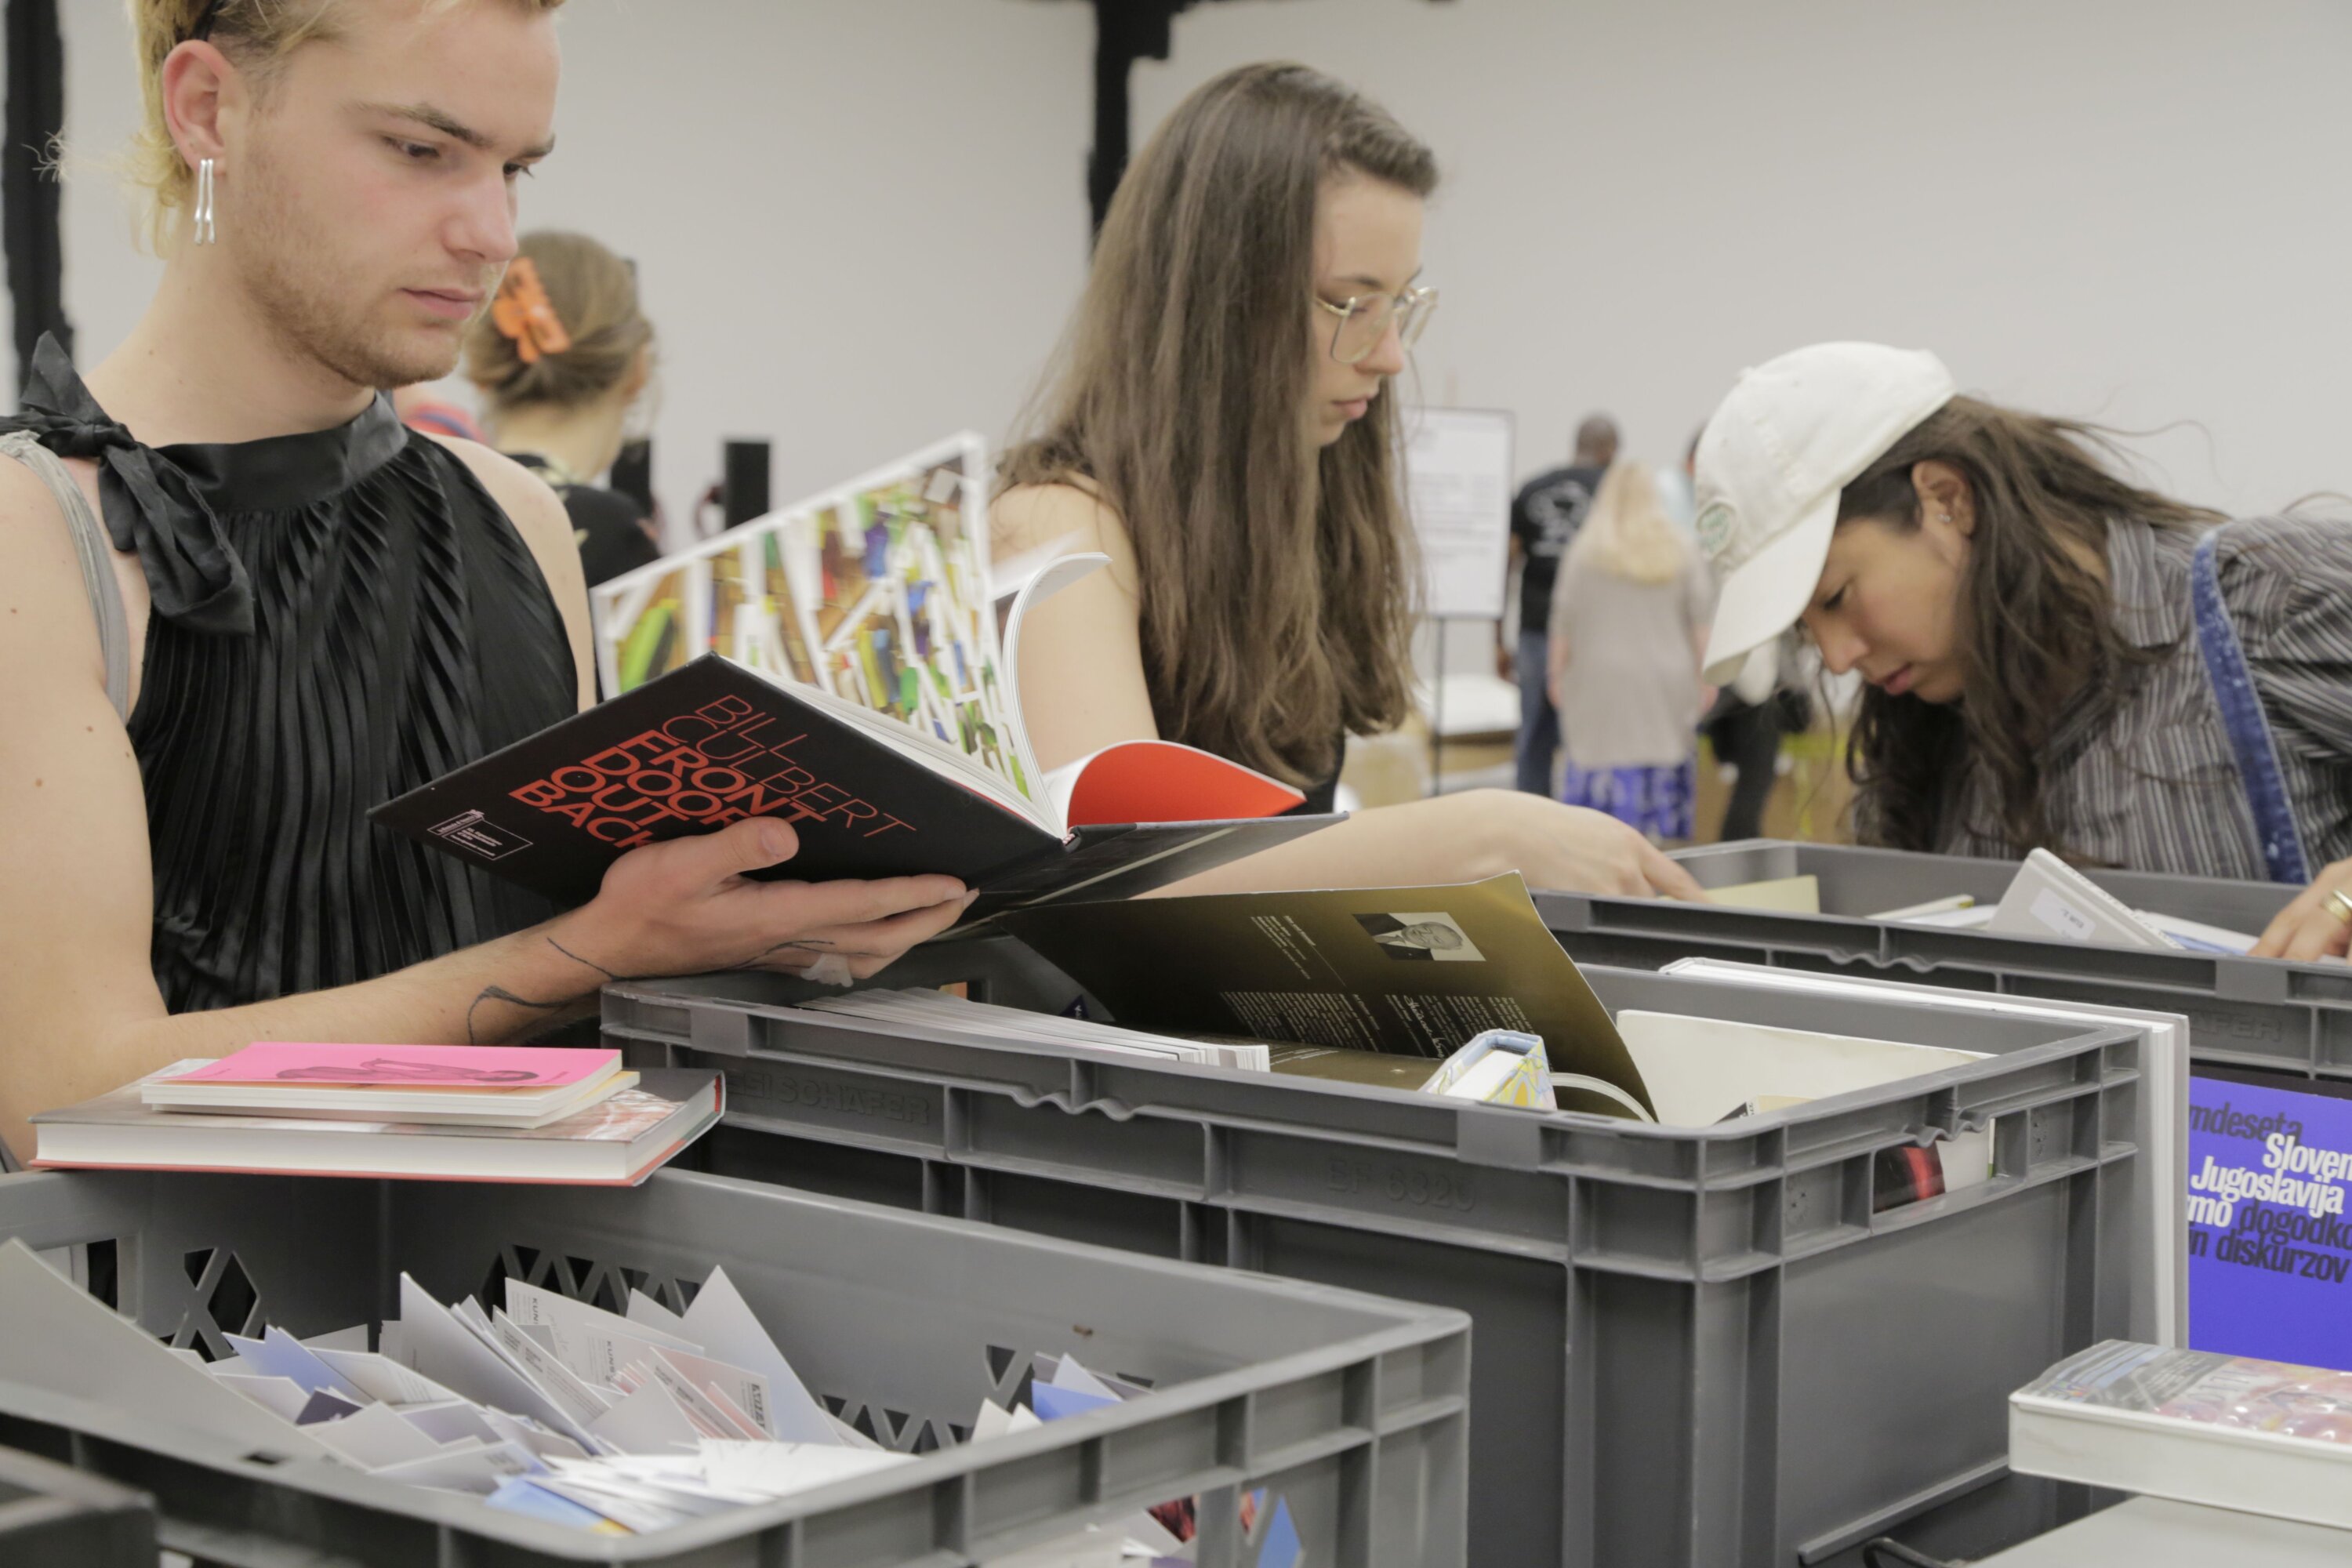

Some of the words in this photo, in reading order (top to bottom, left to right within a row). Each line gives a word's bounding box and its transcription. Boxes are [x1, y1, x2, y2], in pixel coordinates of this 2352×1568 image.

[695, 695, 808, 764] BILL
[551, 766, 690, 826] OUT
[618, 730, 828, 823] FRONT
[662, 716, 916, 837] CULBERT
[2191, 1156, 2345, 1218] Jugoslavija
[2216, 1228, 2350, 1284] diskurzov
